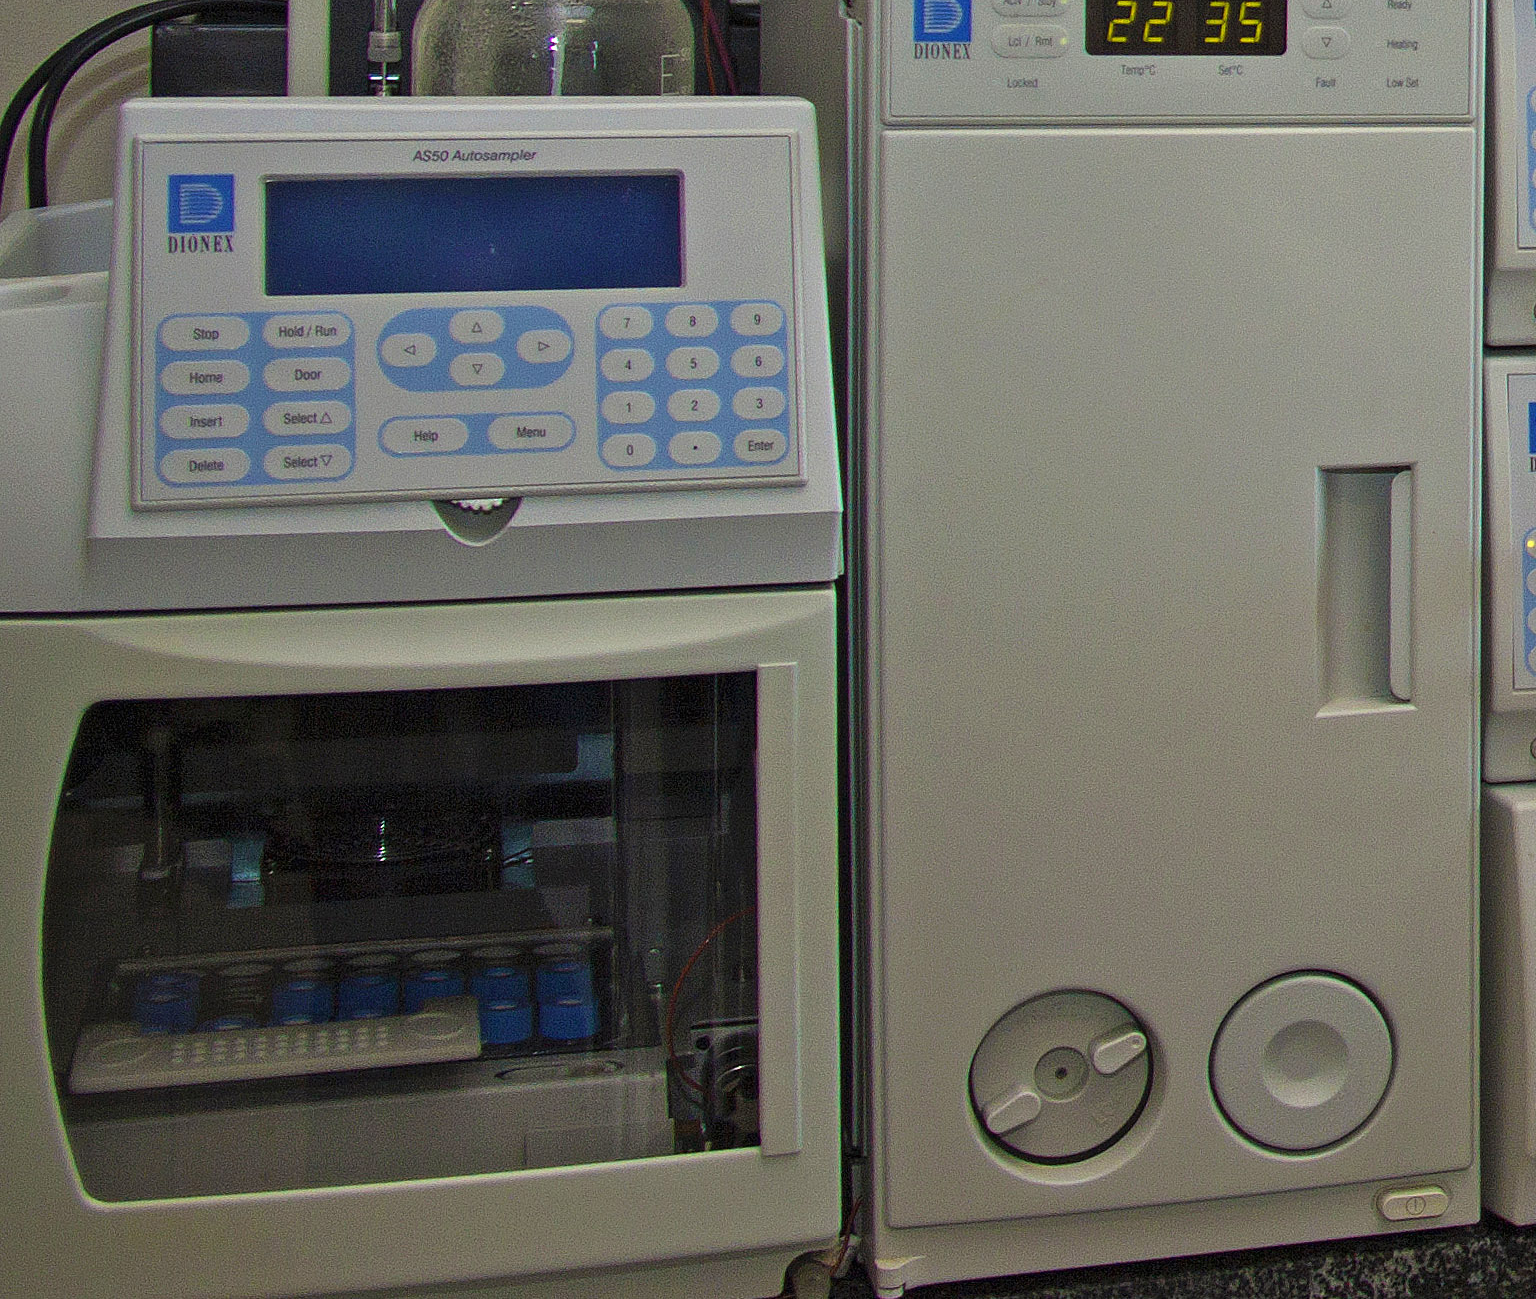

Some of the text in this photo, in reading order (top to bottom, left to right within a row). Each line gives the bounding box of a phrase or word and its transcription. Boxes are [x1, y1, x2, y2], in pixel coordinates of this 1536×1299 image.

[1387, 0, 1412, 11] Ready
[1107, 0, 1173, 43] 22
[1205, 1, 1262, 43] 35
[913, 43, 971, 60] DIONEX
[1387, 39, 1418, 51] Heating
[1007, 78, 1038, 88] Locked
[1316, 78, 1336, 88] Fault
[1387, 78, 1419, 88] Low Set
[413, 150, 537, 164] AS50 Autosampler
[167, 235, 234, 253] DIONEX
[193, 328, 219, 343] Stop
[278, 323, 337, 338] Hold Run
[189, 372, 223, 384] Home
[294, 368, 321, 380] Door
[189, 415, 222, 428] Insert
[189, 459, 224, 472] Delete
